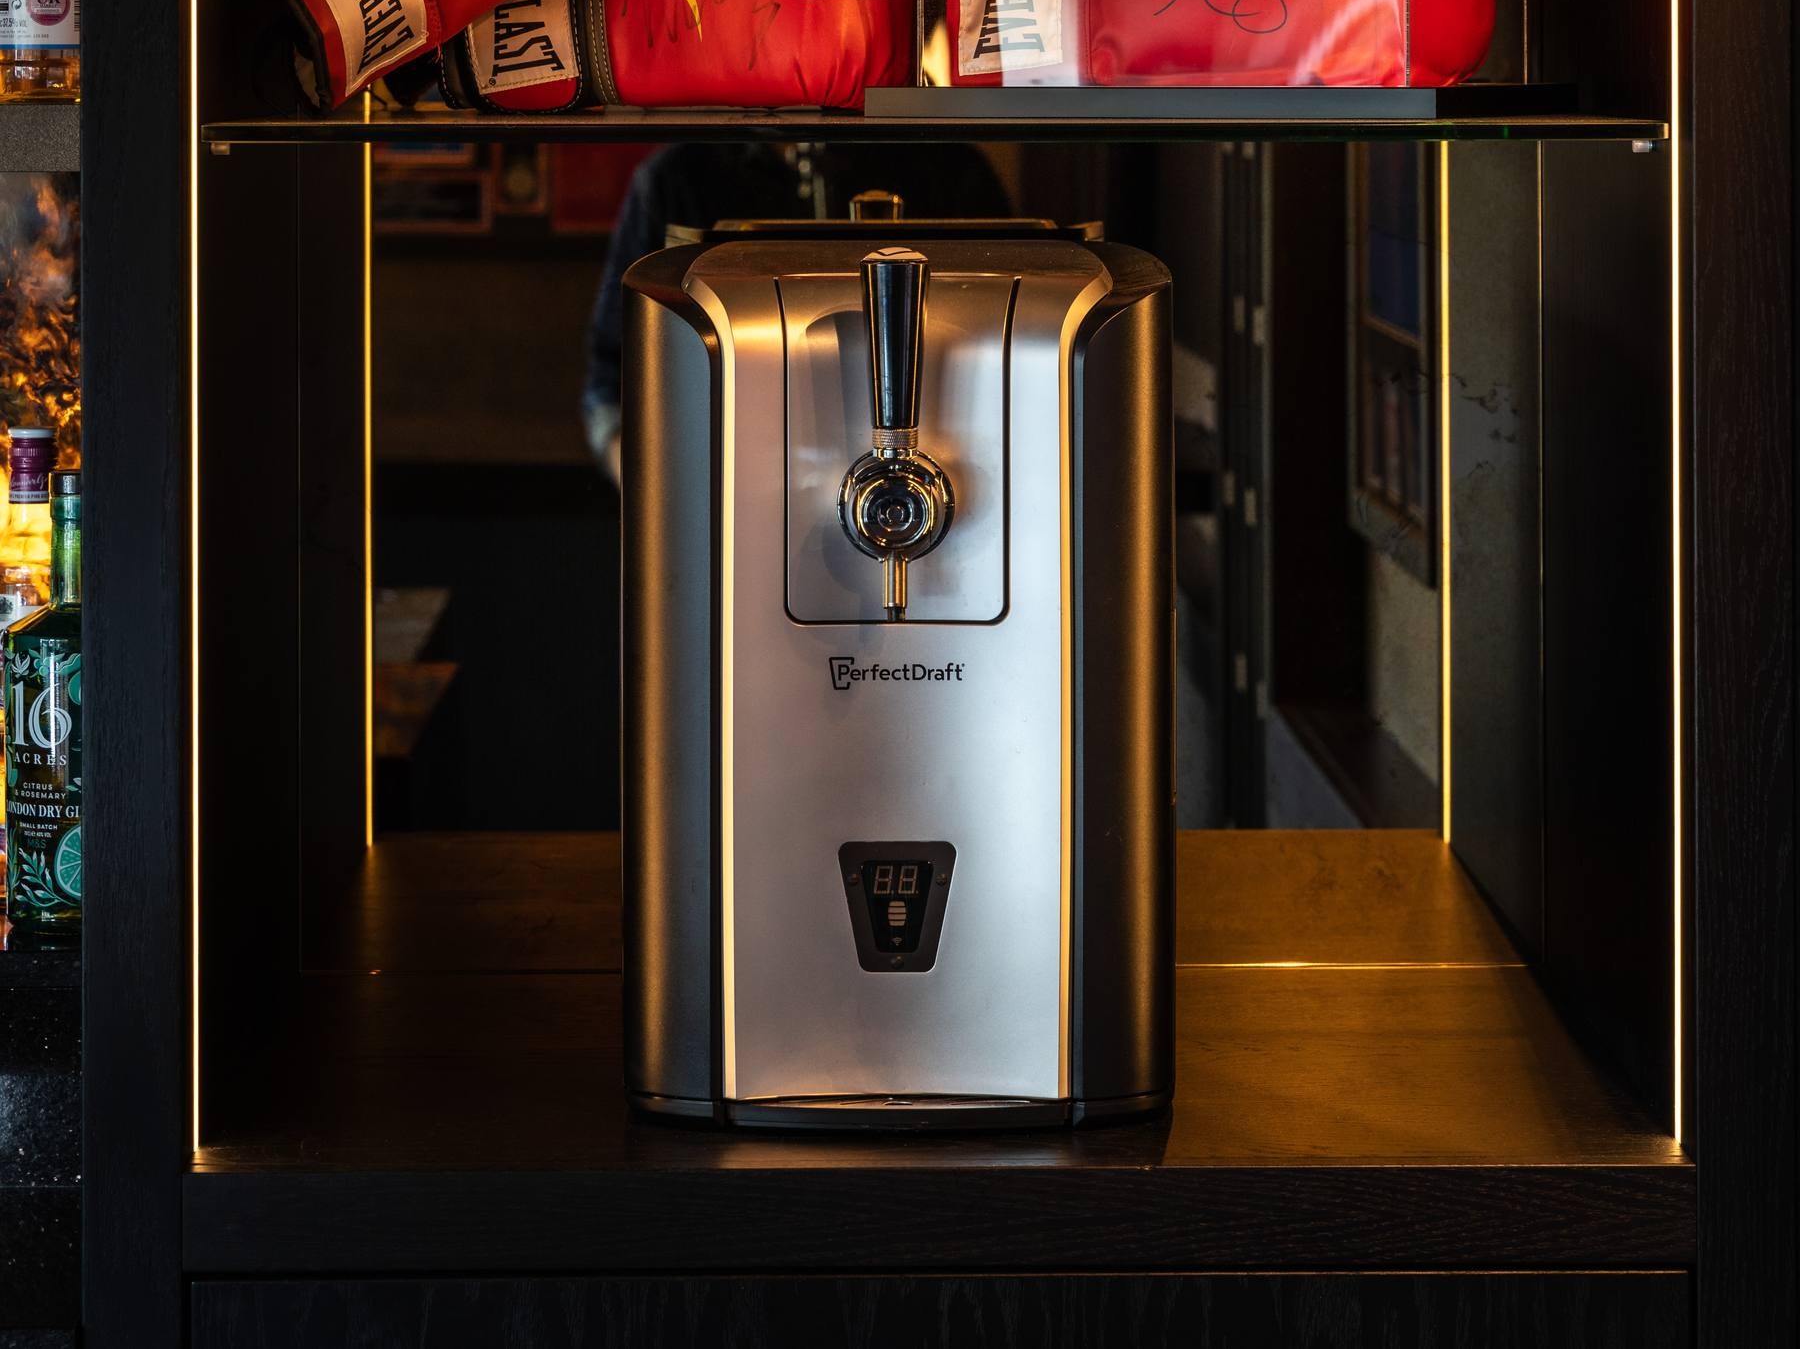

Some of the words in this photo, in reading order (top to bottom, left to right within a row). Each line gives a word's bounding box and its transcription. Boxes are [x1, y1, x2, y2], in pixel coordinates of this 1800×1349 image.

[835, 661, 963, 683] PerfectDraft
[12, 681, 72, 748] 16
[14, 752, 67, 766] ACRES
[23, 782, 53, 790] CITRUS
[21, 790, 66, 800] ROSEMARY
[39, 805, 62, 818] DRY
